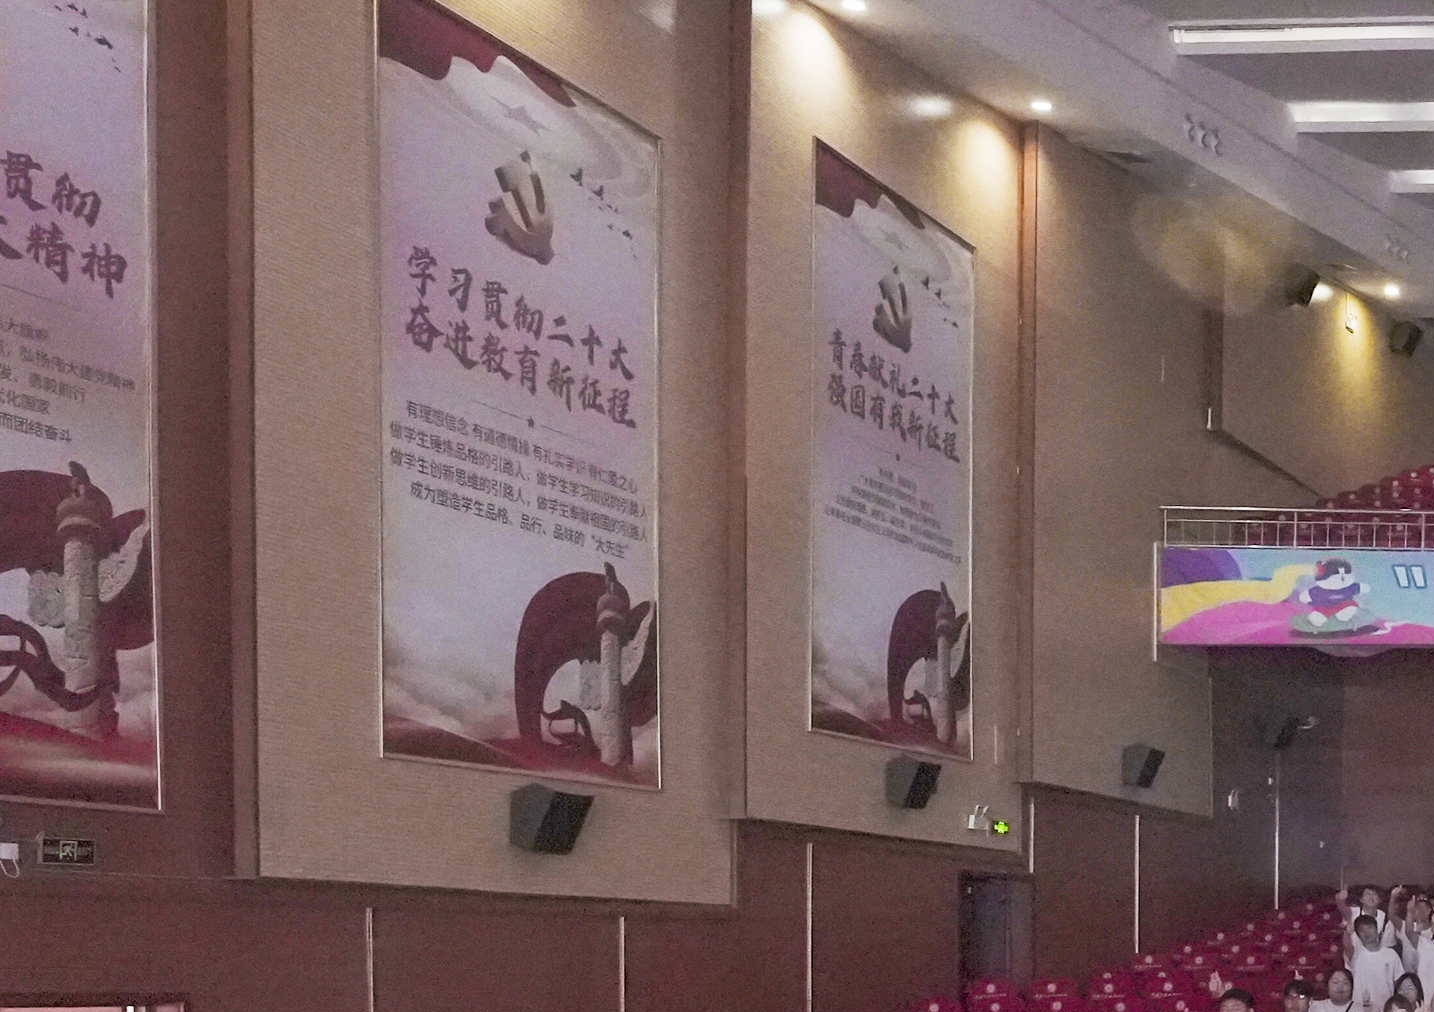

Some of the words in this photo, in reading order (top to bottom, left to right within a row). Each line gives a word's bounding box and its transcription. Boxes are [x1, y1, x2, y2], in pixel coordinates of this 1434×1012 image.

[405, 299, 636, 429] 奋进教育新征程
[407, 245, 635, 381] 学习贯彻二十大
[828, 328, 958, 425] 青春献礼二十大
[828, 373, 960, 463] 强国有我新征程
